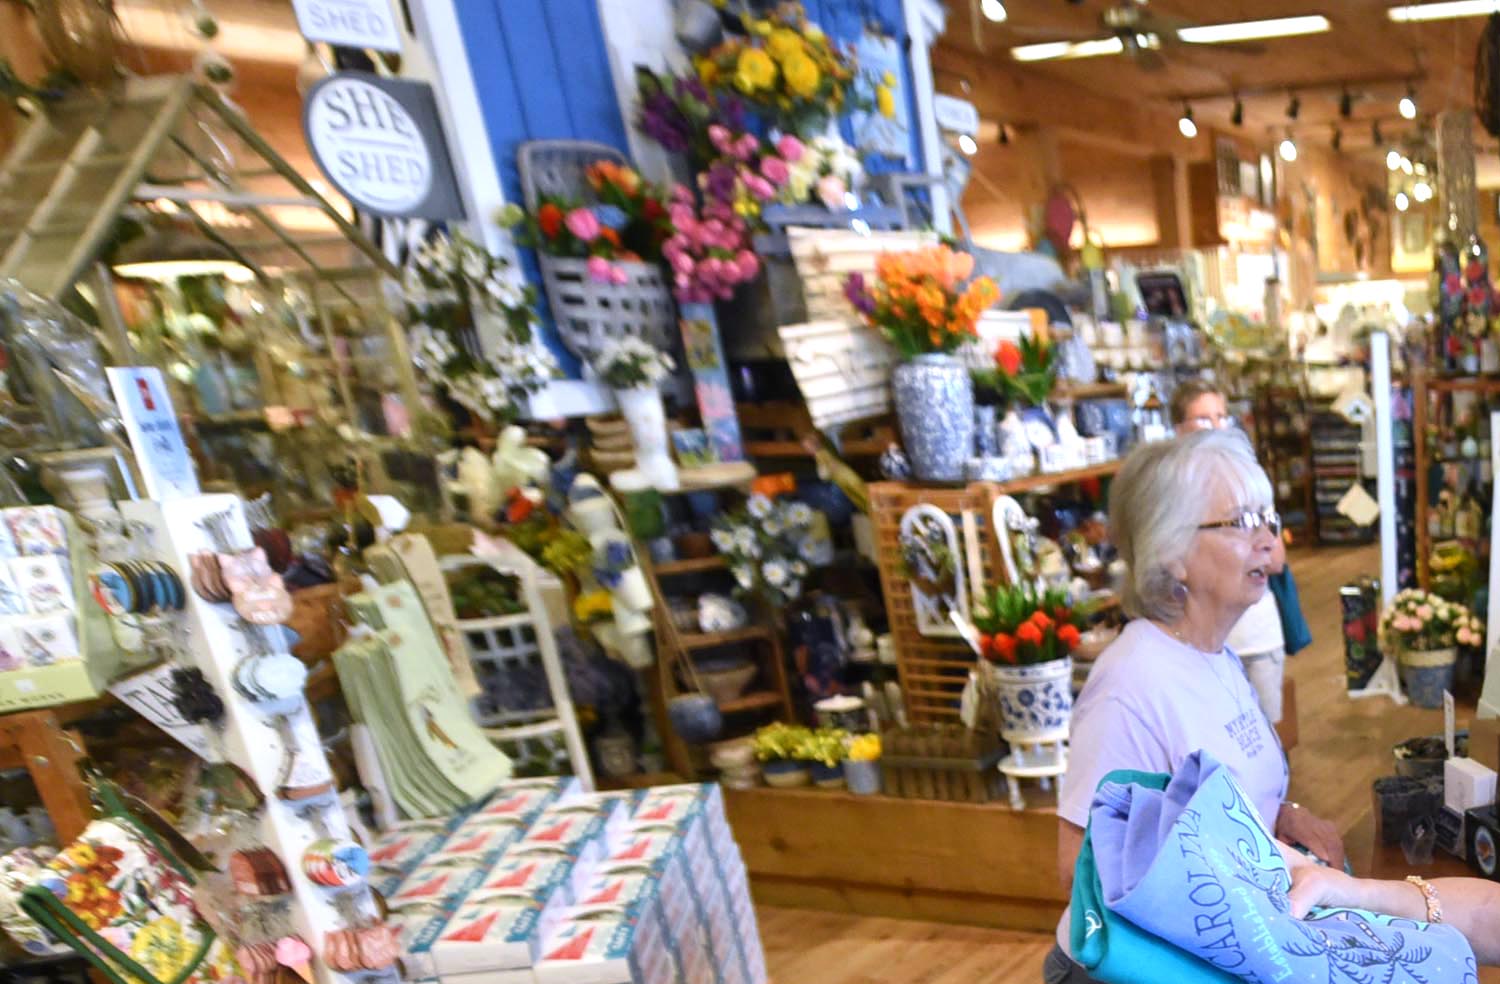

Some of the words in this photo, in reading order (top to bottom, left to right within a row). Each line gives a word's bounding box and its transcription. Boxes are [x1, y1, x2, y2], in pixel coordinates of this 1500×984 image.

[323, 87, 415, 140] SHE
[337, 150, 425, 185] SHED
[1175, 808, 1246, 970] CAROLINA
